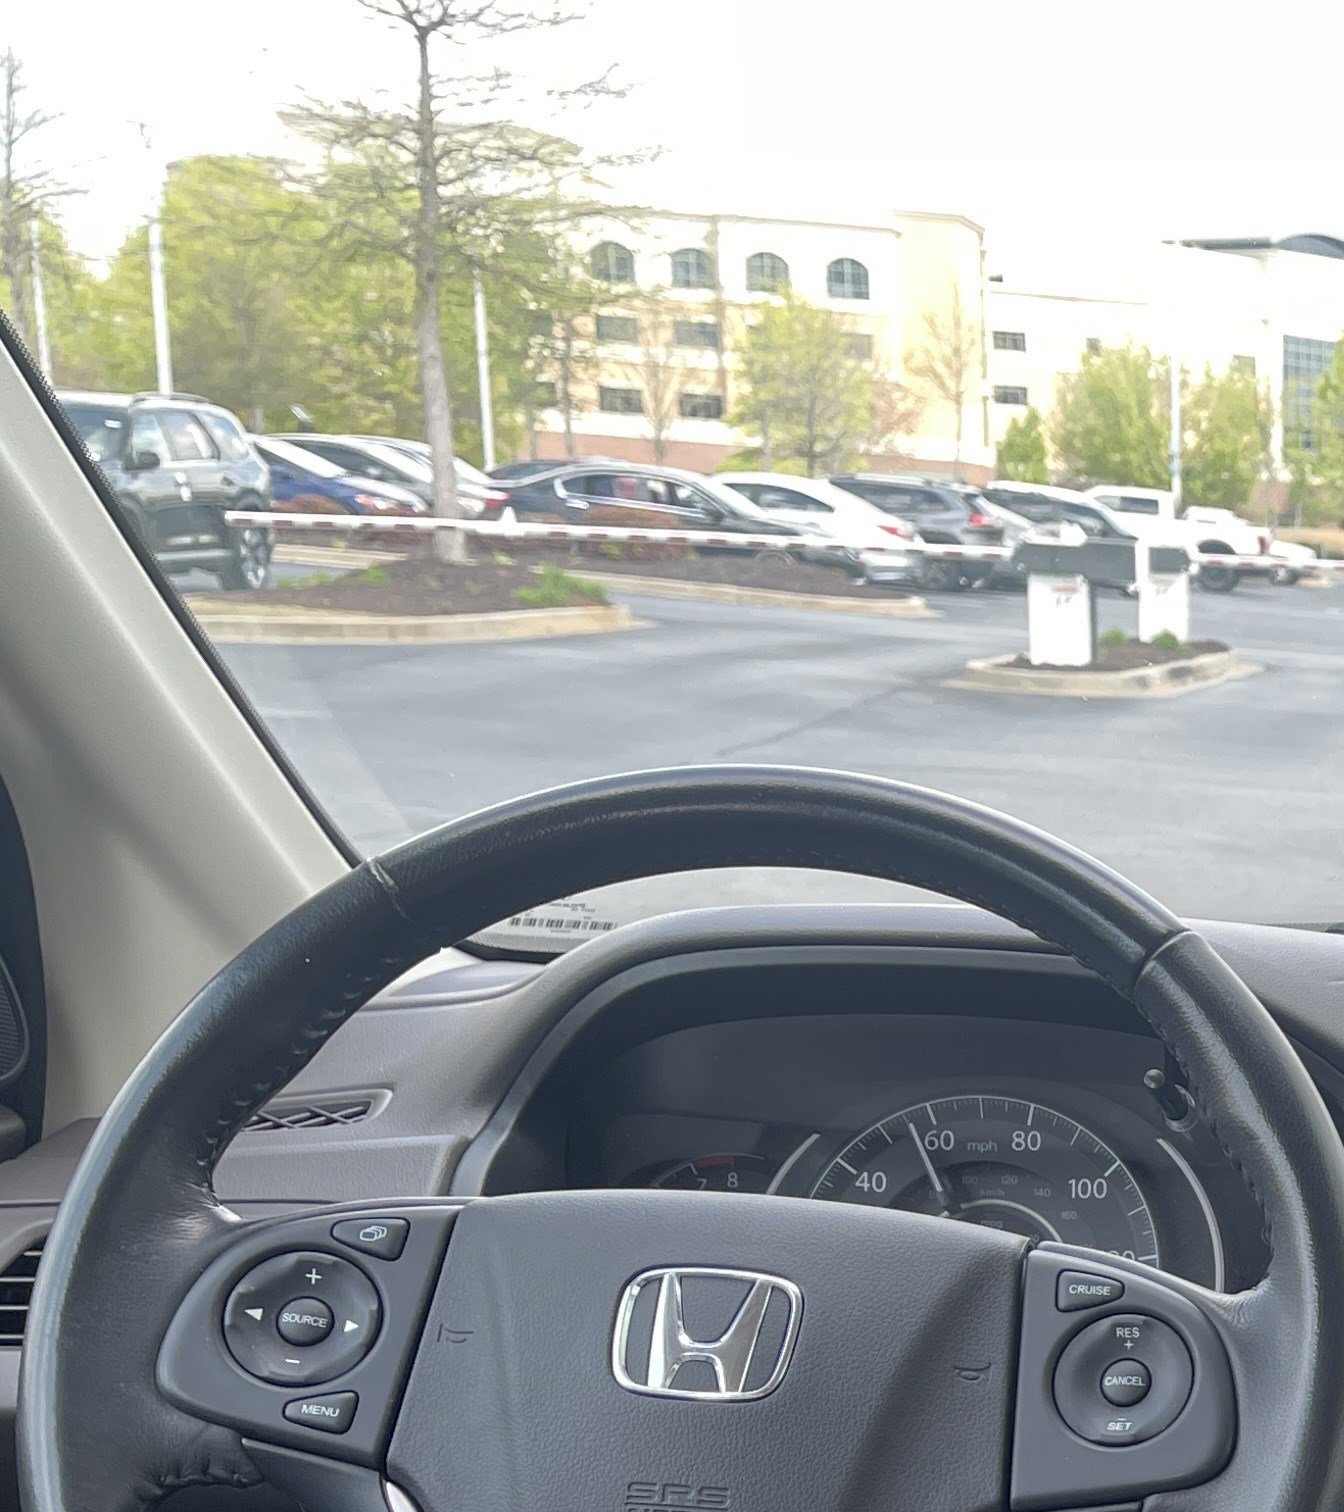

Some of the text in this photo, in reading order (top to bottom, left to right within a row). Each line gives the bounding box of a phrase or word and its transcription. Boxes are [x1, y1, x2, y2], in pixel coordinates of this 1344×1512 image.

[924, 1130, 955, 1150] 60
[966, 1140, 998, 1154] mph
[1011, 1130, 1042, 1151] 80
[727, 1172, 738, 1188] 8
[856, 1172, 886, 1192] 40
[1068, 1178, 1108, 1199] 100
[1068, 1284, 1112, 1296] CRUISE
[282, 1312, 328, 1328] SOURCE
[1116, 1326, 1141, 1338] RES
[1104, 1375, 1146, 1387] CANCEL
[301, 1404, 340, 1418] MENU
[1106, 1421, 1133, 1431] SET
[626, 1481, 731, 1506] SRS
